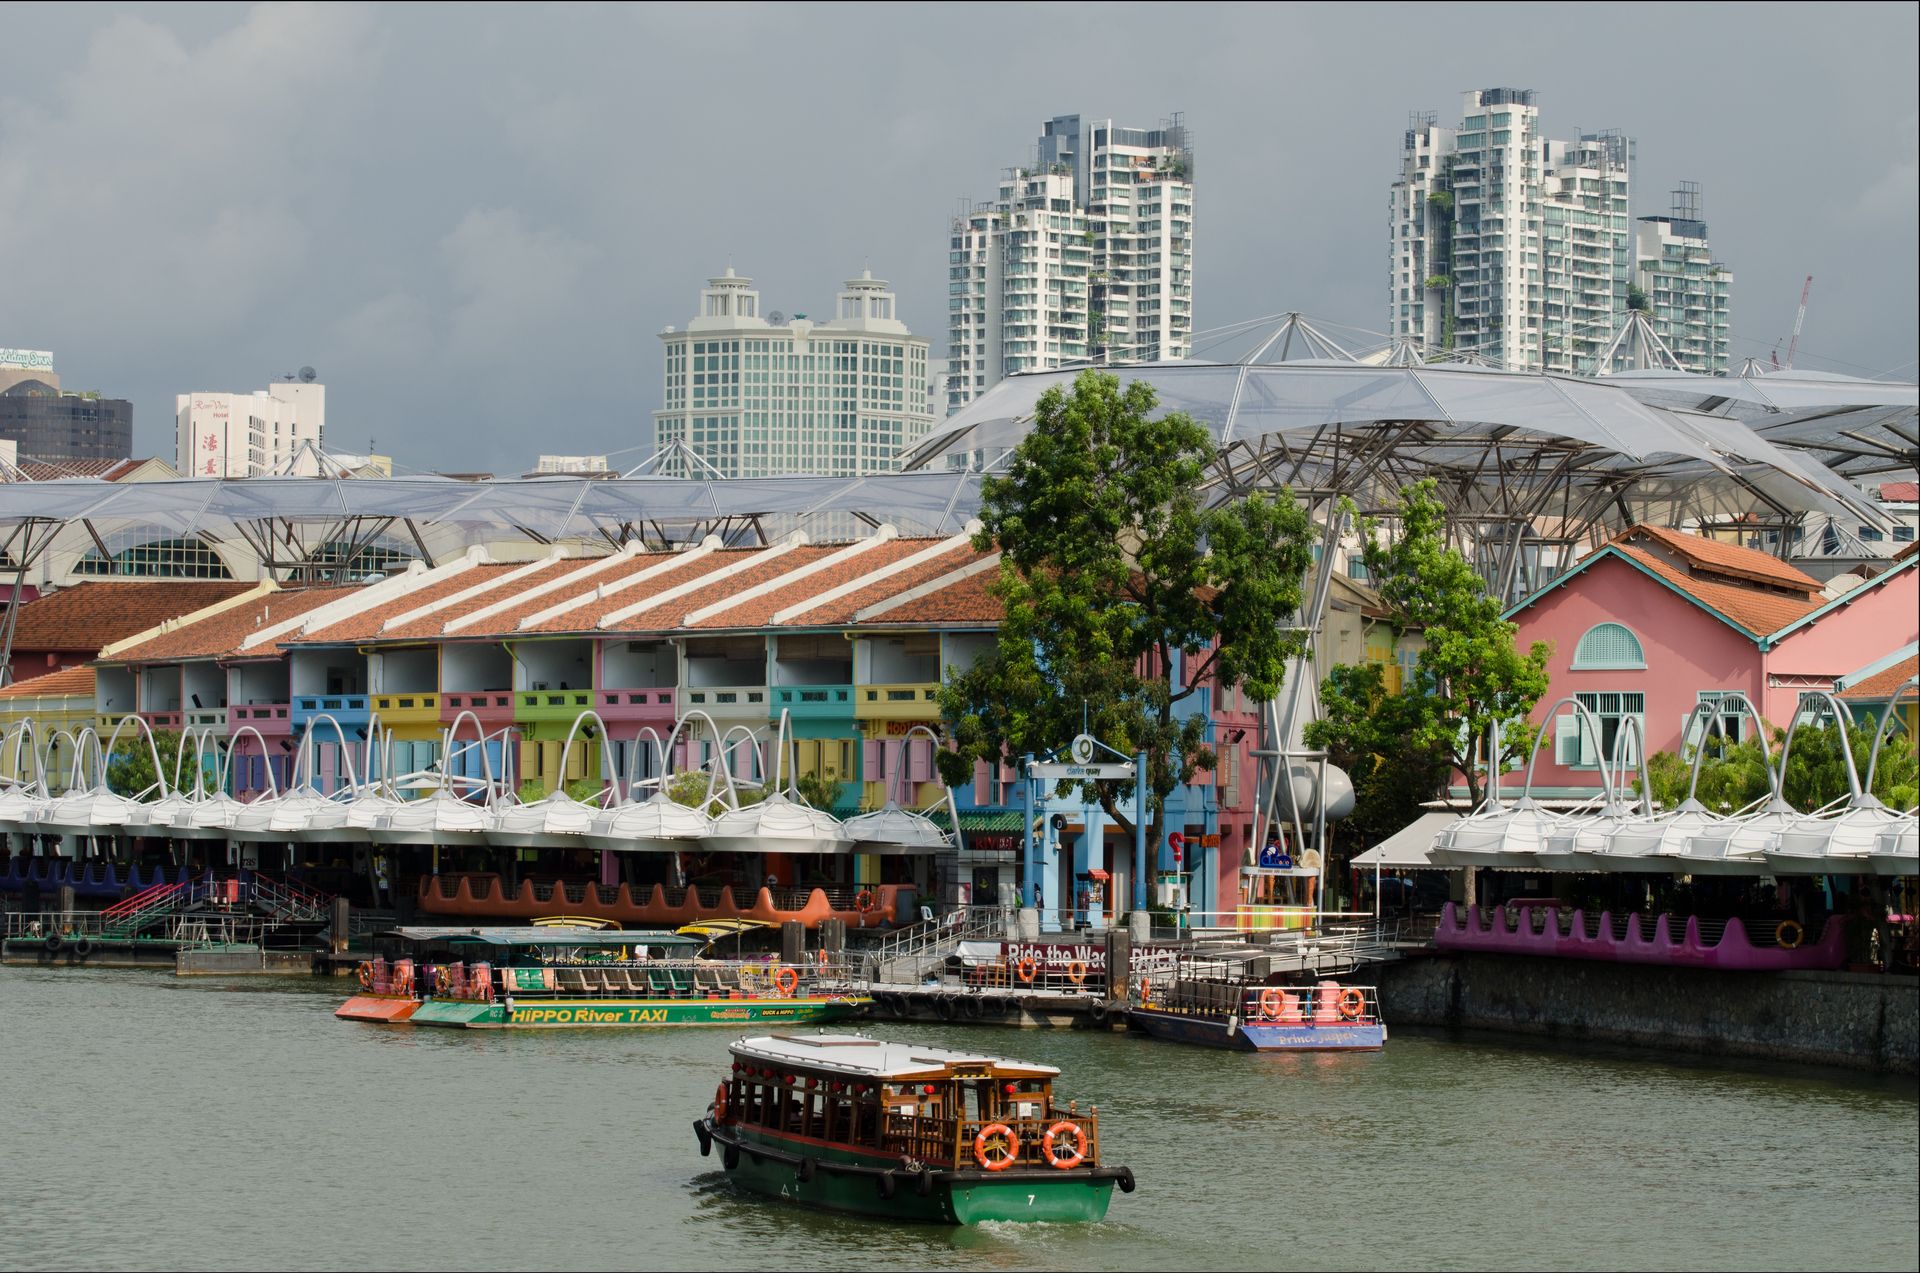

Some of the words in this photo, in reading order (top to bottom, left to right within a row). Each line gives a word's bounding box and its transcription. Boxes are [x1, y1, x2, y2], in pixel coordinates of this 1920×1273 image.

[0, 348, 29, 368] oliday
[30, 351, 53, 366] Inn
[1085, 767, 1101, 776] quay
[1007, 943, 1044, 967] Ride
[1046, 945, 1072, 967] the
[574, 1008, 623, 1022] River
[628, 1009, 669, 1022] TAXI
[1027, 1194, 1035, 1207] 7
